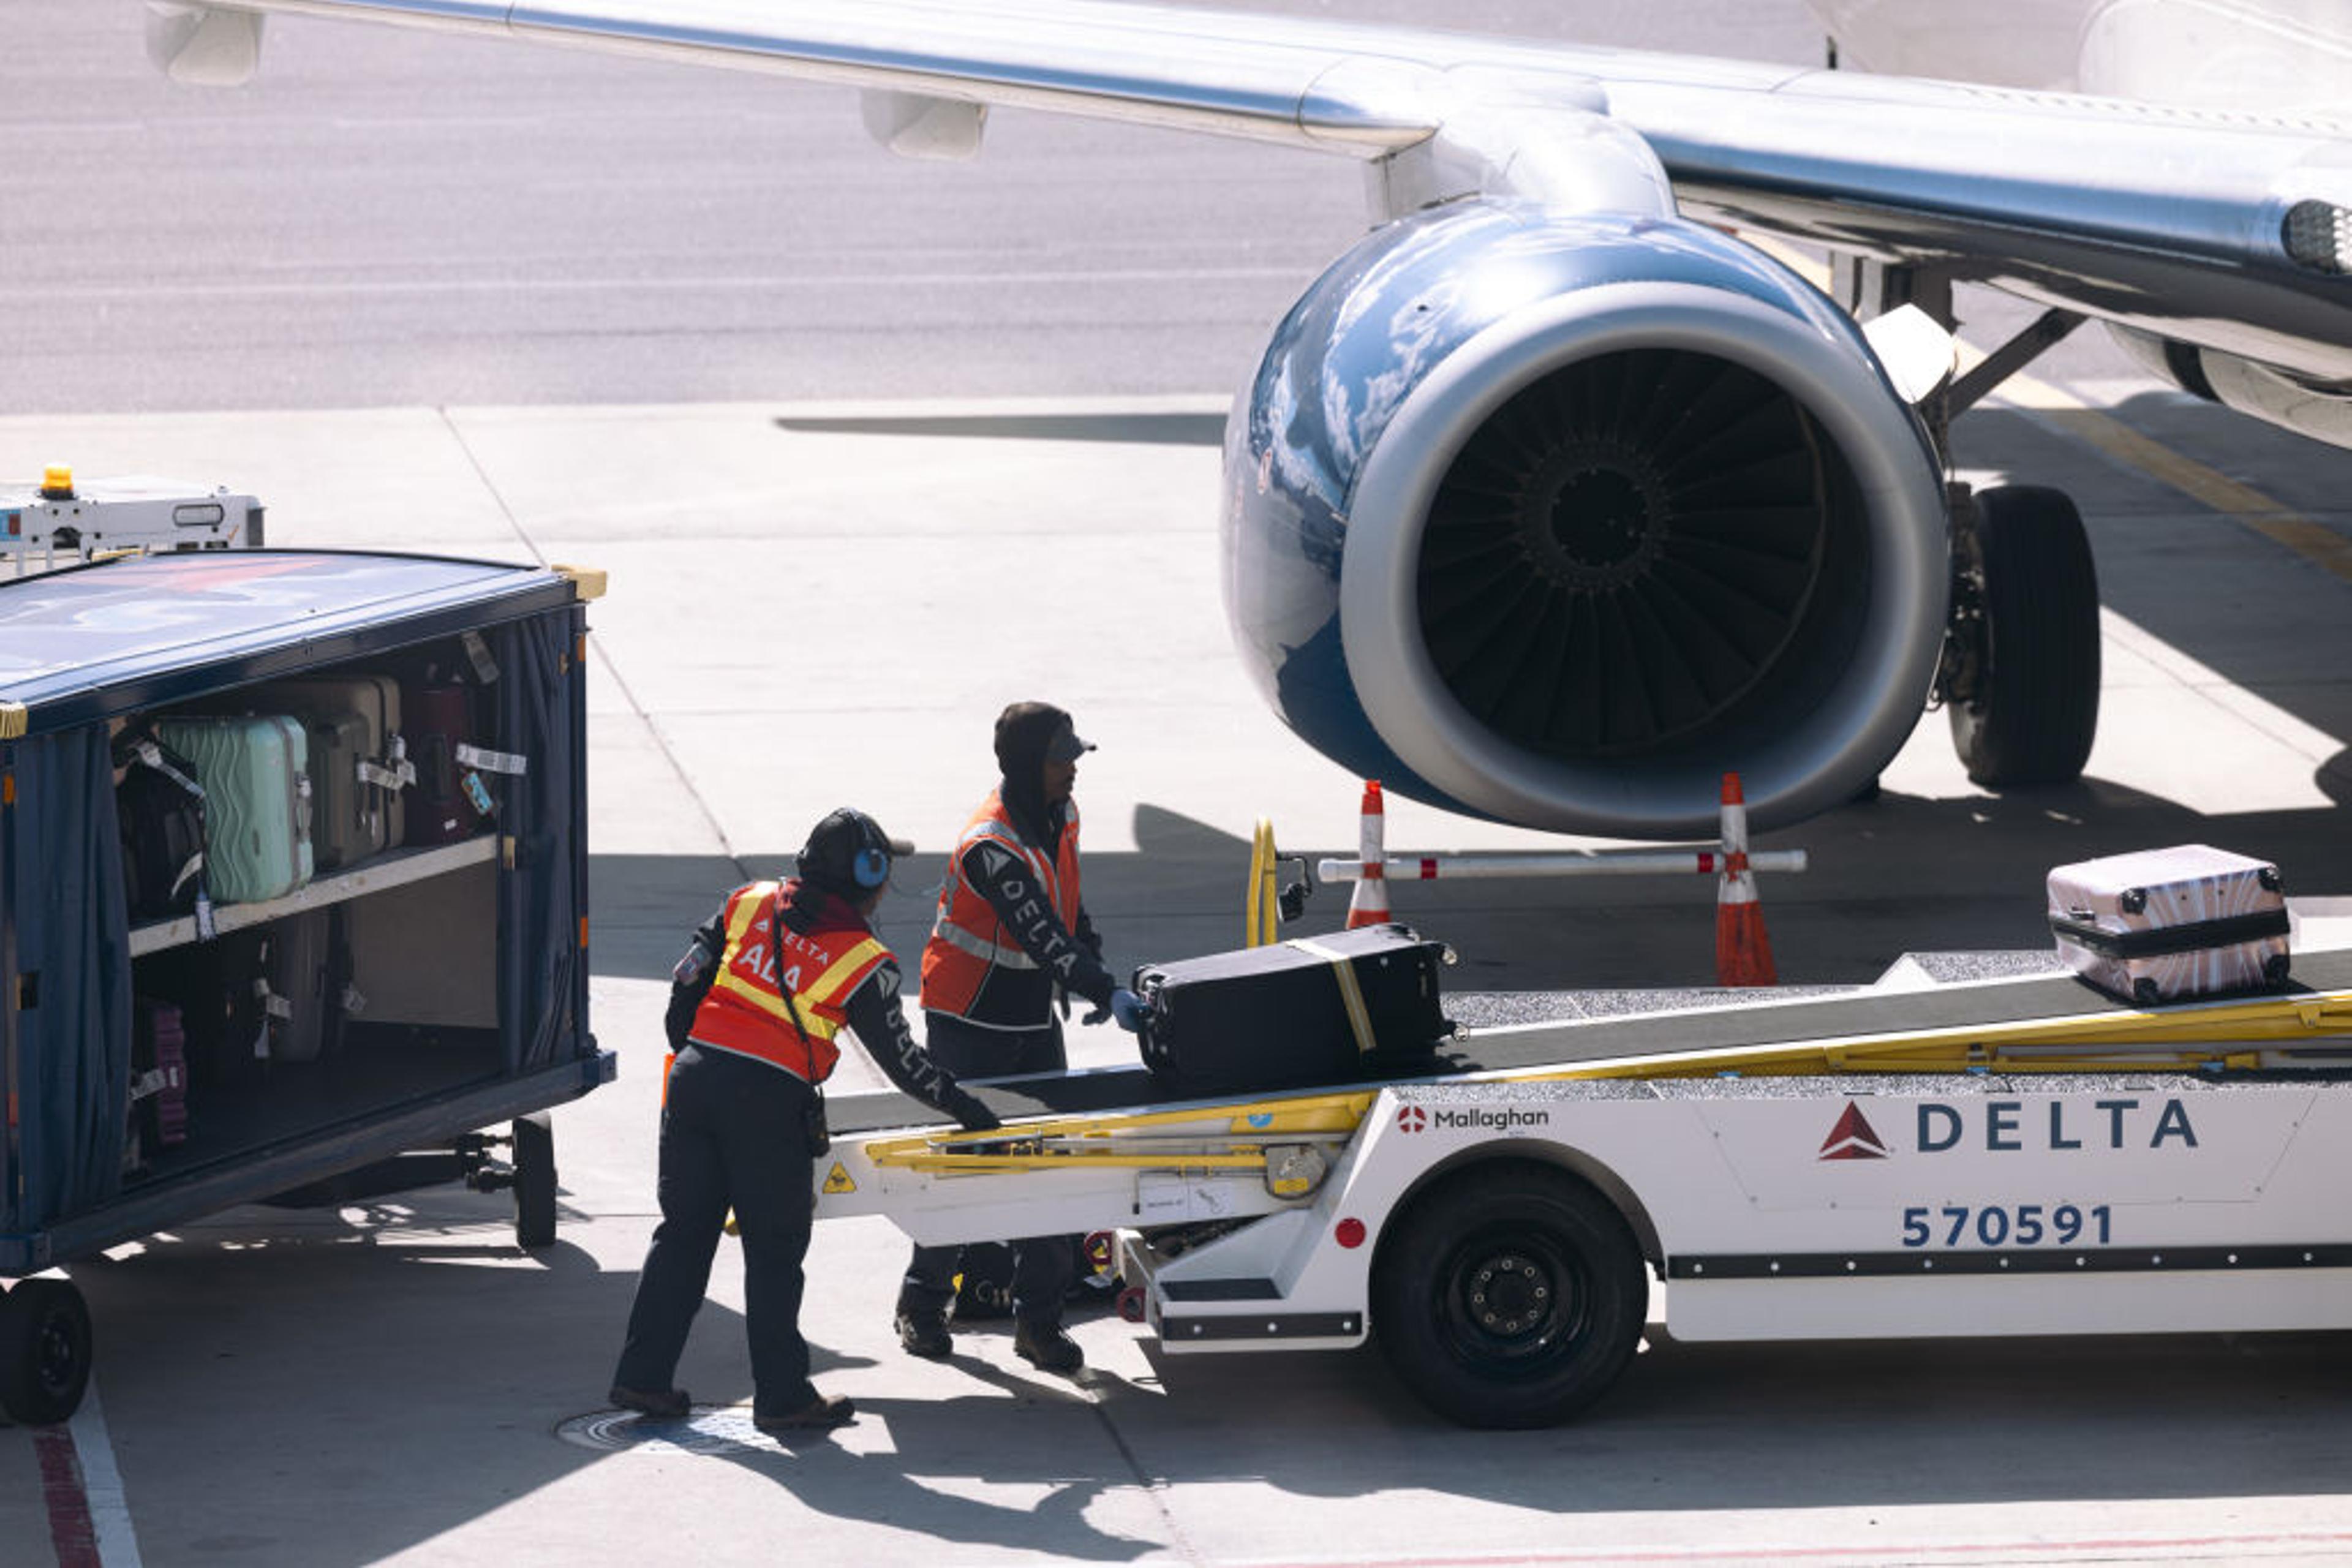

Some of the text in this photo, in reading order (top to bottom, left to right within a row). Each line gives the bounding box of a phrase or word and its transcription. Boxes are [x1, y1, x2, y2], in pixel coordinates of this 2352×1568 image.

[779, 924, 829, 966] ELTA
[1001, 880, 1077, 978] DELTA
[737, 943, 801, 992] ALA
[886, 1005, 941, 1101] DELTA
[1434, 1107, 1550, 1130] Mallaghan
[1917, 1099, 2199, 1153] DELTA
[1902, 1205, 2111, 1248] 570591
